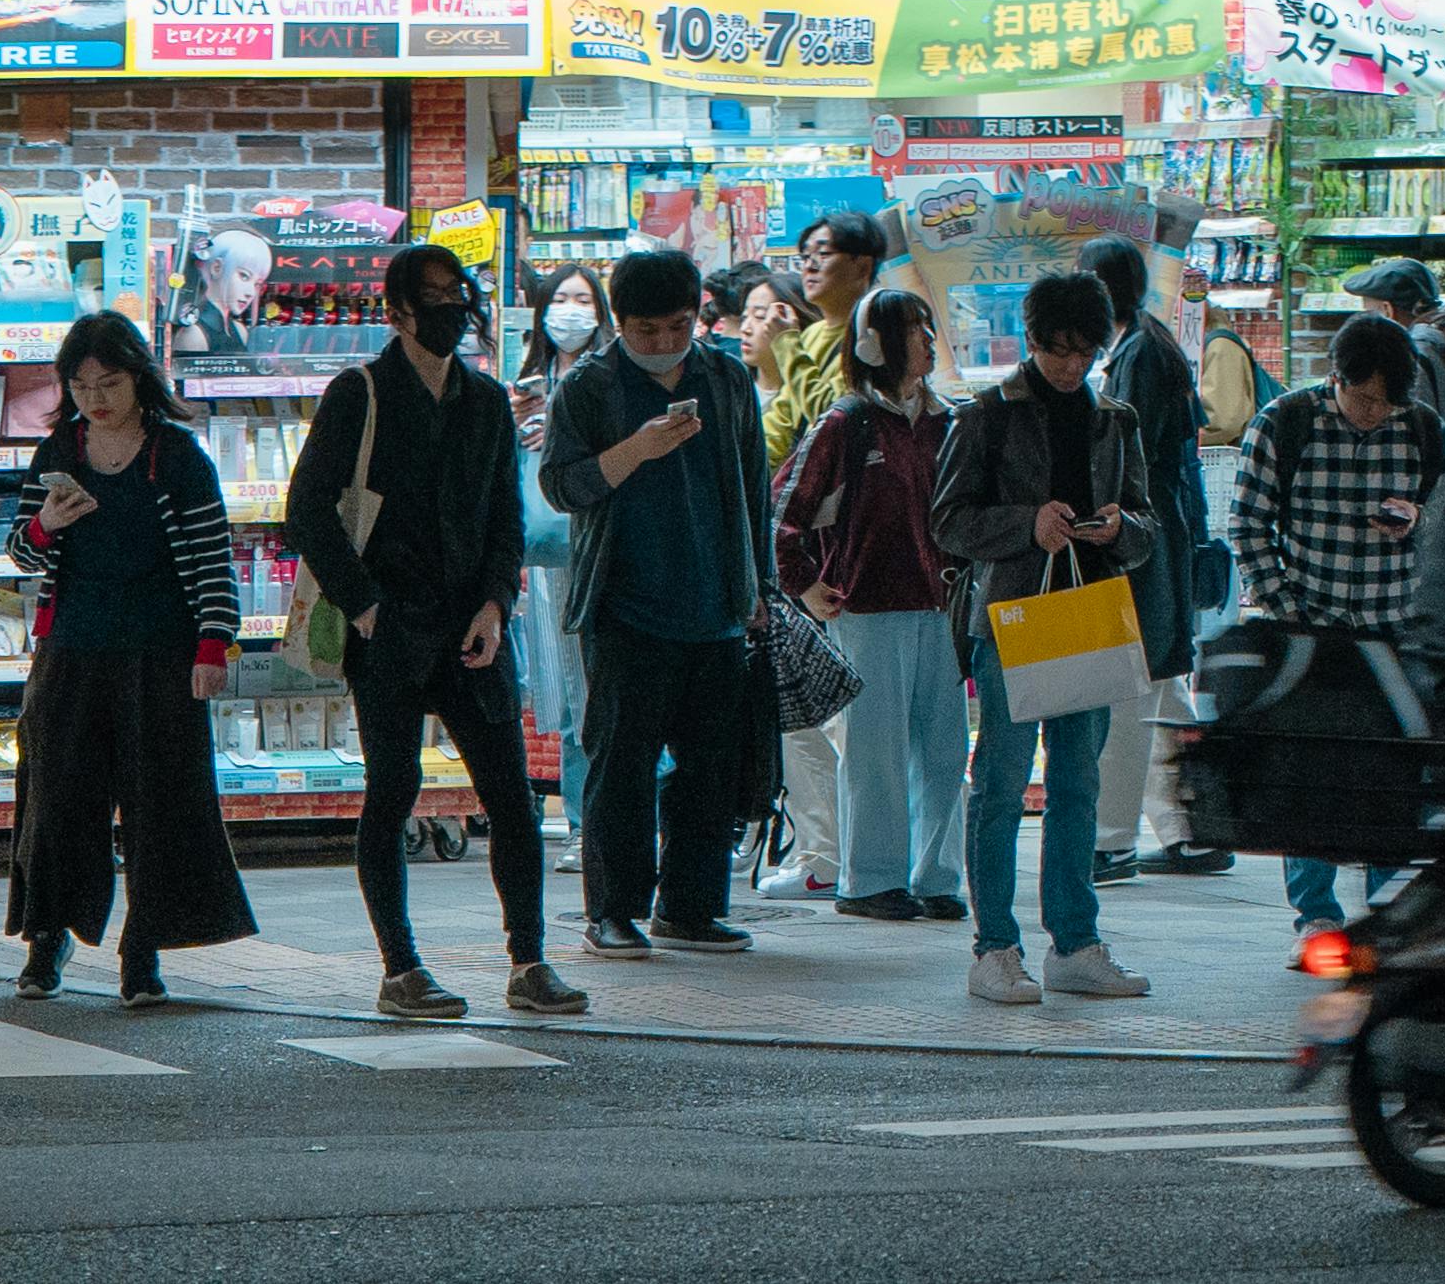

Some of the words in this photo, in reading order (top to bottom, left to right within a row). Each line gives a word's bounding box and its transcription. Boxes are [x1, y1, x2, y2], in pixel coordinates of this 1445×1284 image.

[165, 27, 258, 45] ヒロインメイク
[299, 27, 380, 48] KATE
[832, 17, 873, 41] 折扣
[186, 47, 215, 57] KISS
[217, 47, 237, 57] ME
[584, 45, 610, 57] TAX
[611, 47, 642, 62] FREE
[921, 23, 1196, 77] 享松本清专属优惠
[935, 119, 972, 135] NEW
[982, 118, 1122, 138] 反則級ストレート。
[264, 200, 298, 215] NEW
[920, 189, 978, 226] SNS
[277, 218, 388, 235] 肌にトップコート。
[439, 208, 480, 228] KATE
[276, 256, 391, 268] KATE
[970, 262, 1065, 281] ANESS
[6, 327, 42, 338] 650
